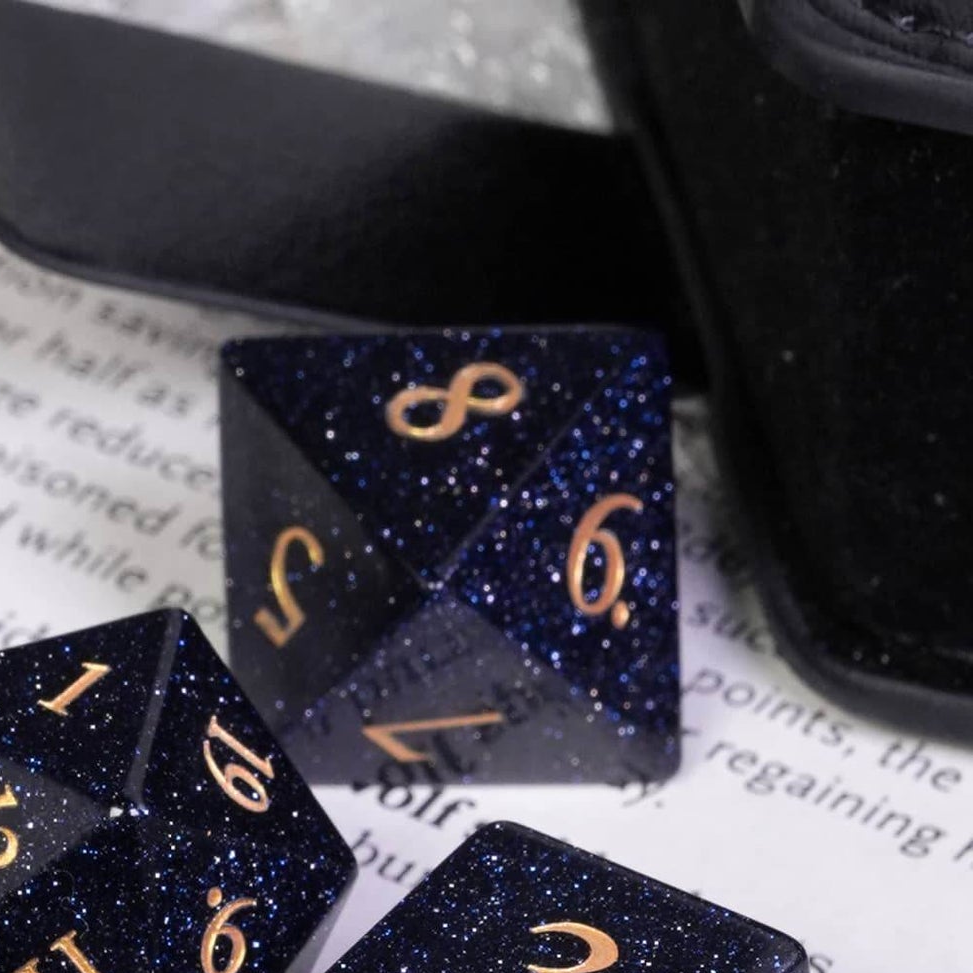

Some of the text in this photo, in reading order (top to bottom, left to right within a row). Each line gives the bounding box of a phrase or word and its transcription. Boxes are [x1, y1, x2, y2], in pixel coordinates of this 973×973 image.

[384, 360, 525, 443] 8
[18, 519, 150, 594] while
[37, 661, 112, 716] 1
[201, 715, 276, 814] 19
[704, 740, 947, 860] regaining
[878, 733, 964, 794] the
